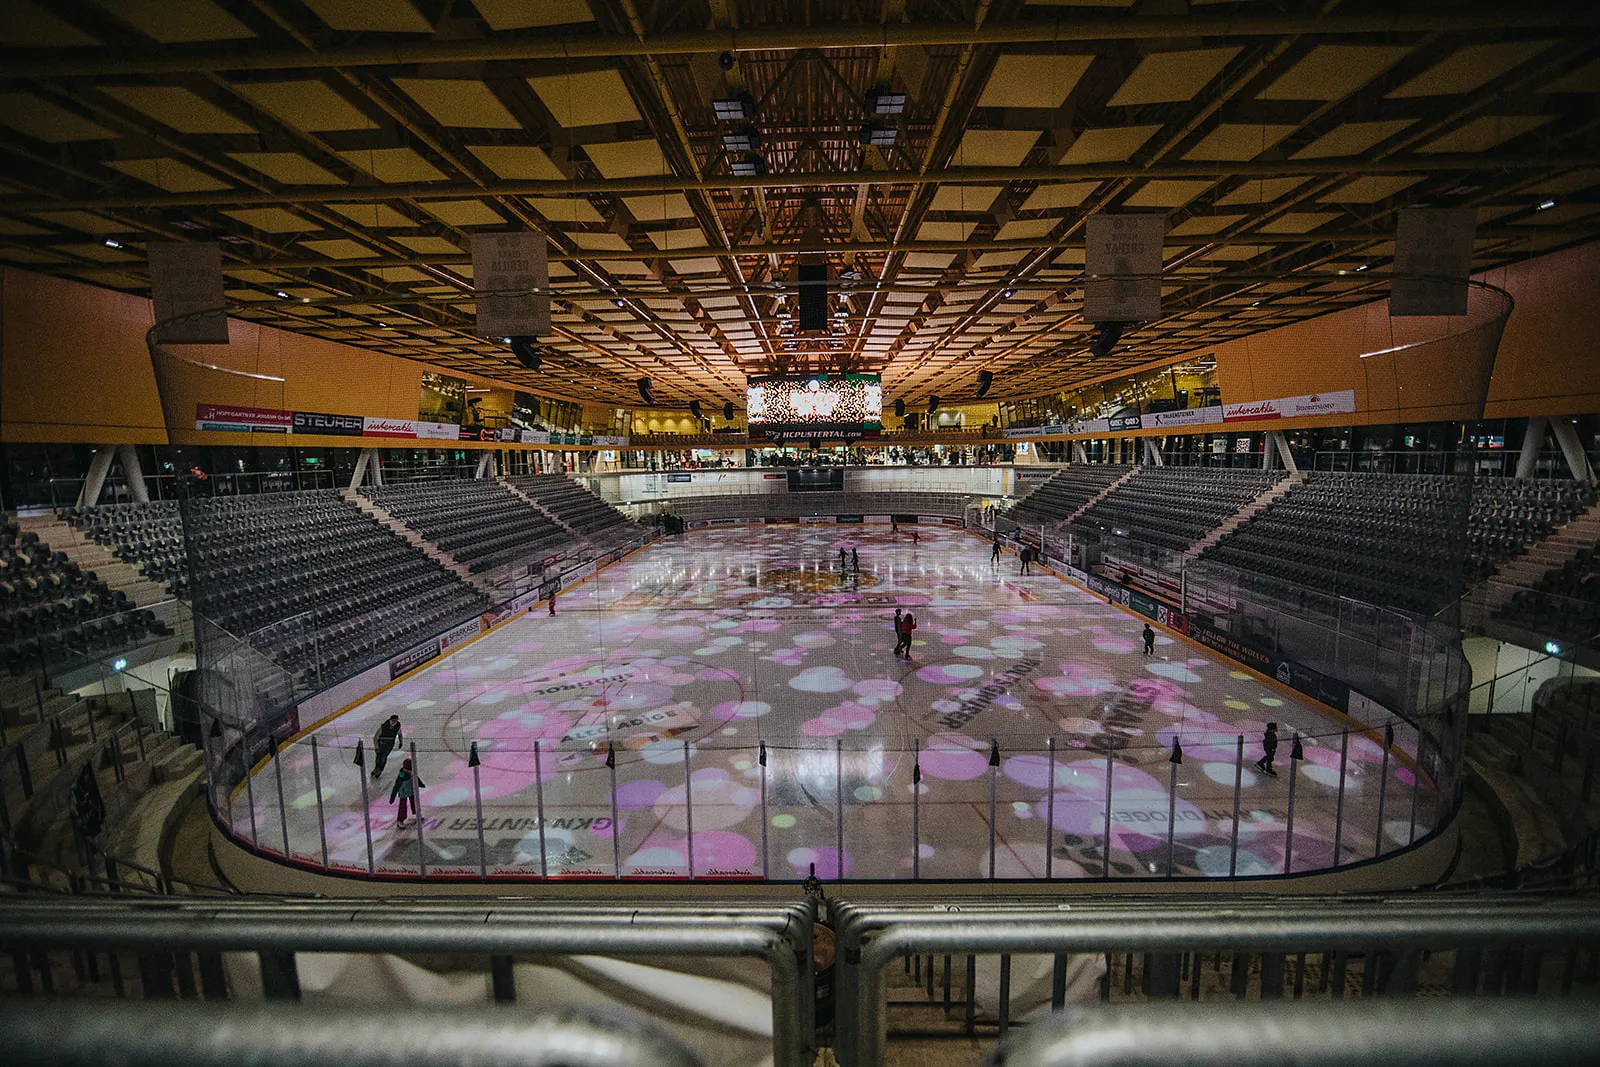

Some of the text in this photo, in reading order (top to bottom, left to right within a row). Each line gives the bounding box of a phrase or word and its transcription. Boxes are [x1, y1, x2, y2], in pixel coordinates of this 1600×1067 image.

[1226, 401, 1276, 417] intercable
[294, 414, 363, 429] STEURER
[367, 420, 414, 432] intercable
[448, 620, 480, 642] SPARKASSE
[561, 726, 610, 743] ALTO
